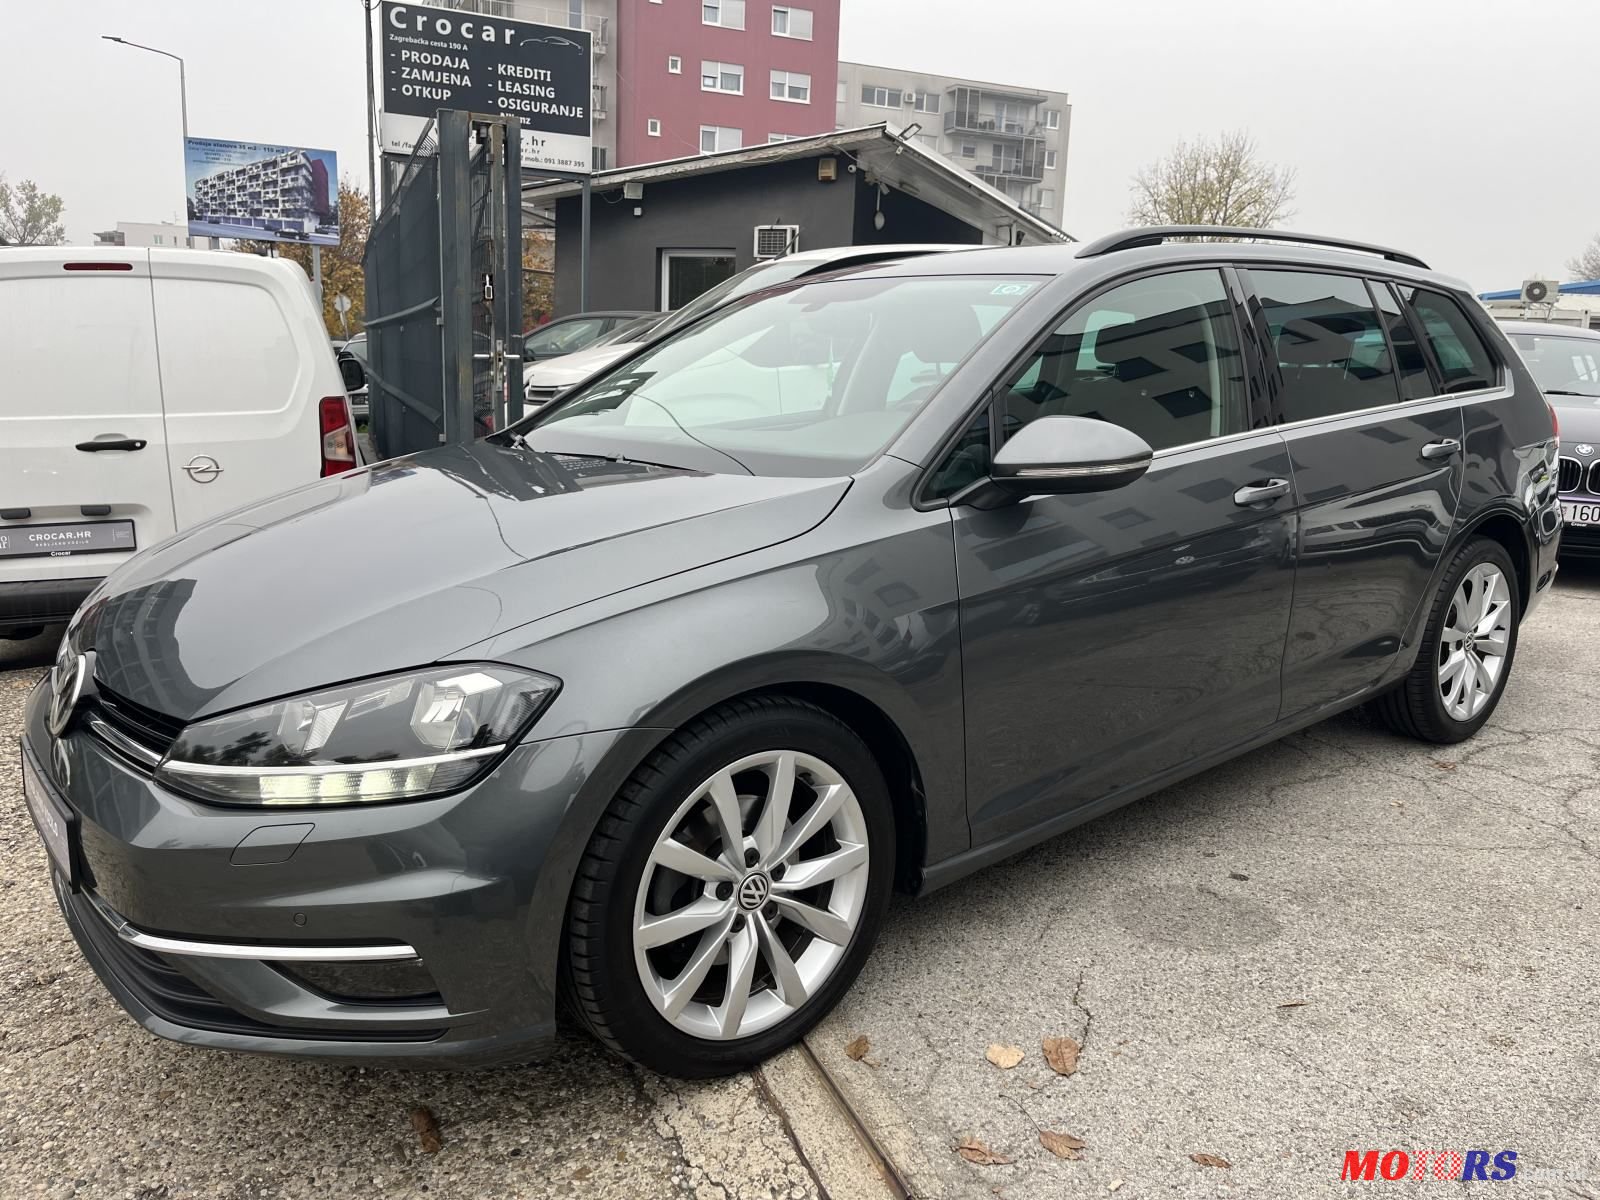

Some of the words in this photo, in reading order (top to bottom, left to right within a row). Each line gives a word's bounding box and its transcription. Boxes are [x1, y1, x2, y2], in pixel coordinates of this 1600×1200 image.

[389, 6, 516, 44] Crocar
[401, 49, 470, 70] PRODAJA
[401, 66, 472, 88] ZAMJENA
[498, 63, 552, 82] KREDITI
[401, 84, 452, 101] OTKUP
[498, 79, 556, 99] LEASING
[497, 96, 584, 119] OSIGURANJE
[28, 530, 92, 542] CROCAR.HR
